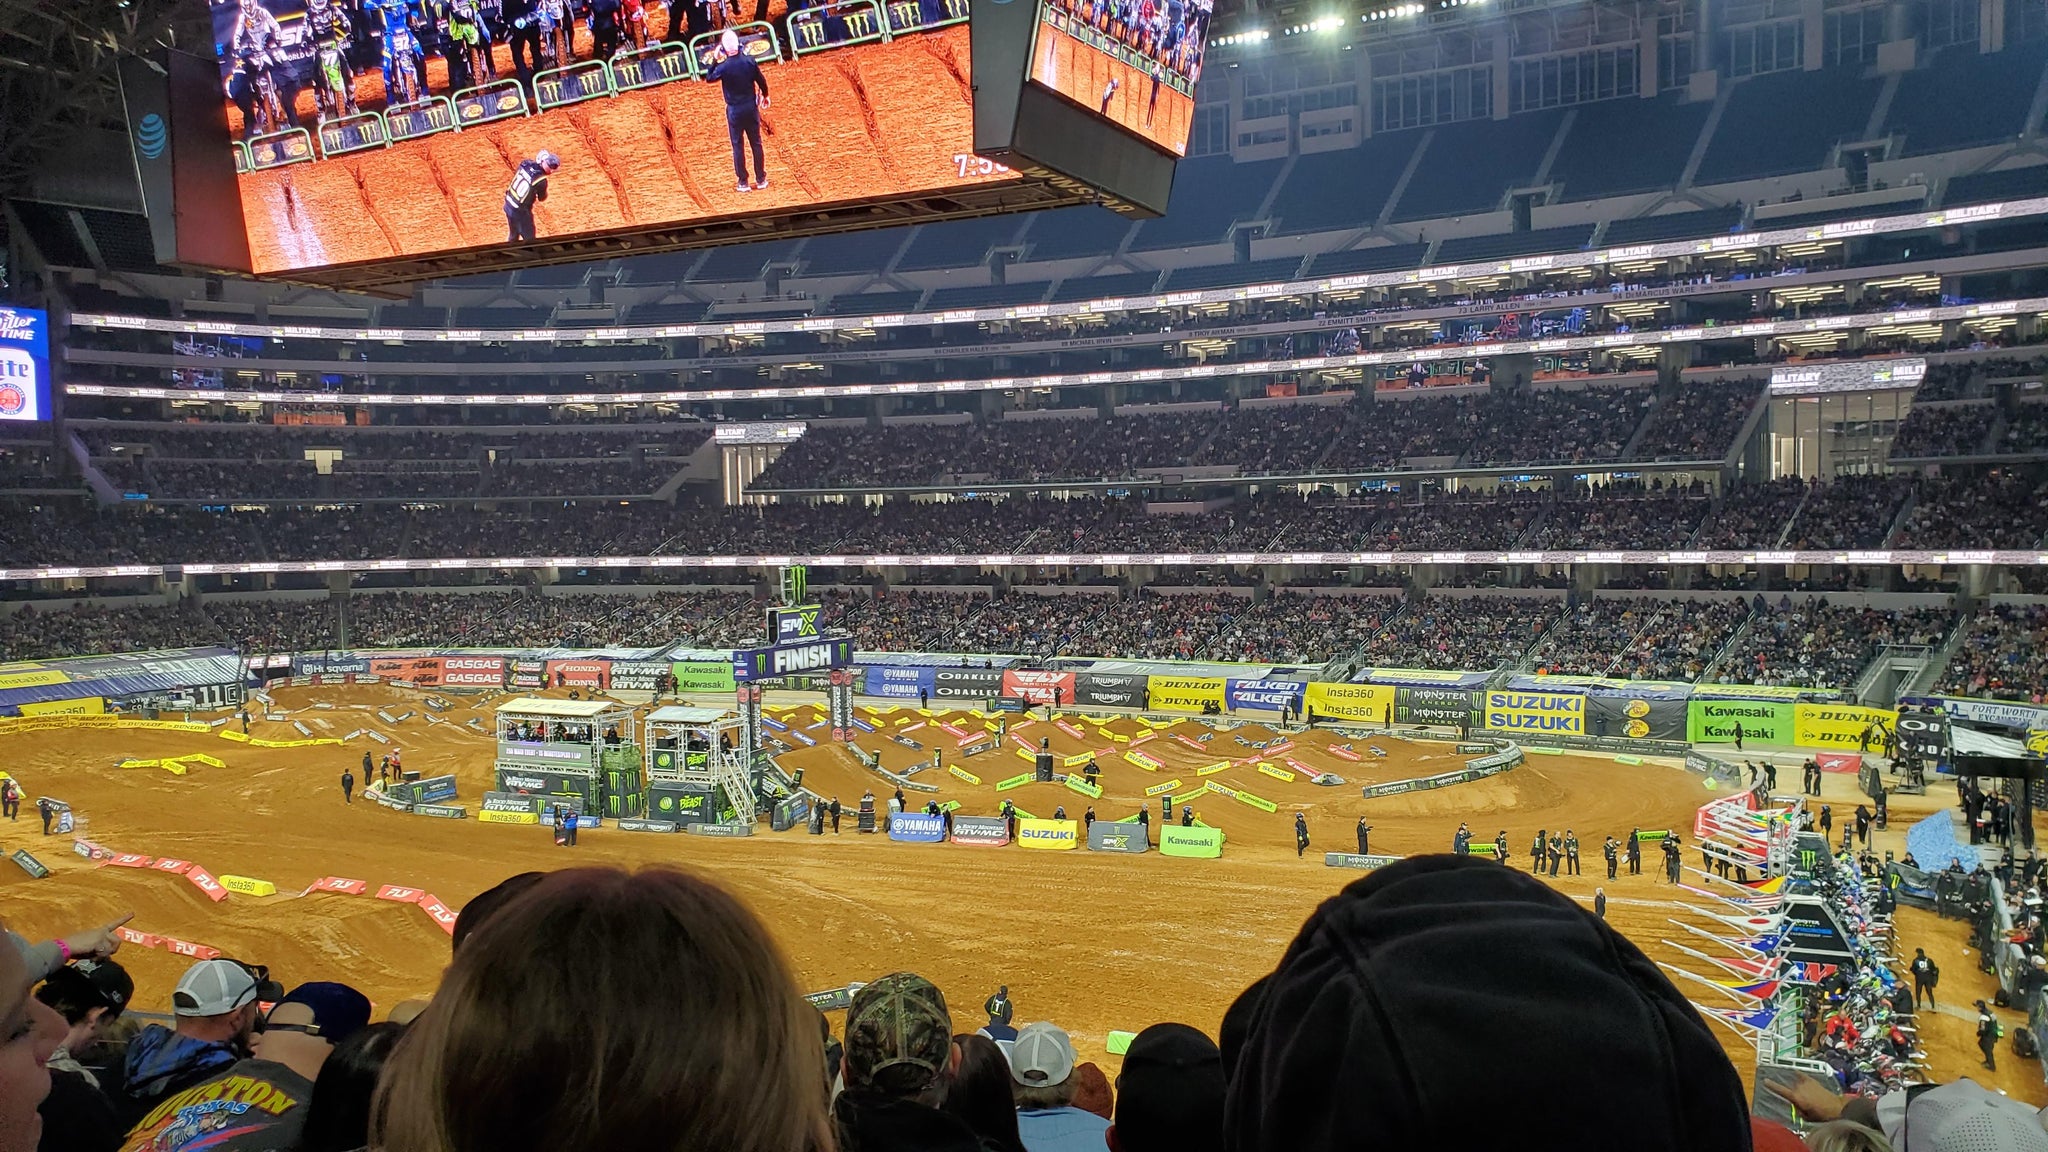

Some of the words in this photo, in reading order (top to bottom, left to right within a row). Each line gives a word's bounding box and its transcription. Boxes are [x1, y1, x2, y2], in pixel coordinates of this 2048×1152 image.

[1672, 286, 1696, 294] WARE
[1470, 305, 1494, 314] LARRY
[1495, 303, 1520, 312] ALLEN
[1327, 318, 1354, 326] EMMITT
[1355, 316, 1377, 324] SMITH
[780, 612, 818, 636] SMX
[774, 644, 832, 674] FINISH
[445, 660, 502, 670] GASGAS
[684, 666, 727, 675] Kawasaki
[445, 673, 502, 683] GASGAS
[890, 670, 919, 679] YAMAHA
[683, 680, 725, 690] Kawasaki
[1092, 677, 1124, 686] TRIUMPH
[1164, 680, 1221, 690] DUNLOP
[1235, 680, 1300, 690] FALKEN
[890, 684, 918, 694] YAMAHA
[1326, 688, 1374, 699] Insta360
[1091, 692, 1124, 702] TRIUMPH
[1414, 690, 1467, 701] MONSTER
[1490, 694, 1580, 711] SUZUKI
[1324, 704, 1373, 716] Insta360
[1413, 708, 1466, 719] MONSTER
[1704, 706, 1774, 718] Kawasaki
[1972, 704, 2000, 714] FORT
[2002, 708, 2039, 718] WORTH
[1490, 713, 1580, 732] SUZUKI
[1704, 725, 1774, 739] Kawsaki
[1262, 764, 1292, 780] SUZUKI
[1148, 781, 1177, 795] SUZUKI
[1206, 782, 1238, 798] SUZUKI
[679, 796, 704, 810] BEAST
[490, 813, 522, 822] Insta360
[905, 819, 941, 832] YAMAHA
[1022, 829, 1074, 840] SUZUKI
[1102, 835, 1130, 848] SMX
[1168, 836, 1214, 847] Kawasaki
[119, 854, 142, 862] FLY
[1348, 857, 1384, 865] MONSTER
[160, 860, 182, 868] FLY
[194, 874, 218, 891] FLY
[226, 879, 256, 892] Insta360
[329, 880, 354, 889] FLY
[386, 888, 412, 898] FLY
[428, 904, 454, 922] FLY
[125, 930, 144, 943] FLY
[176, 942, 198, 956] FLY
[123, 1075, 297, 1138] HOUSTON
[178, 1099, 250, 1119] TEXAS
